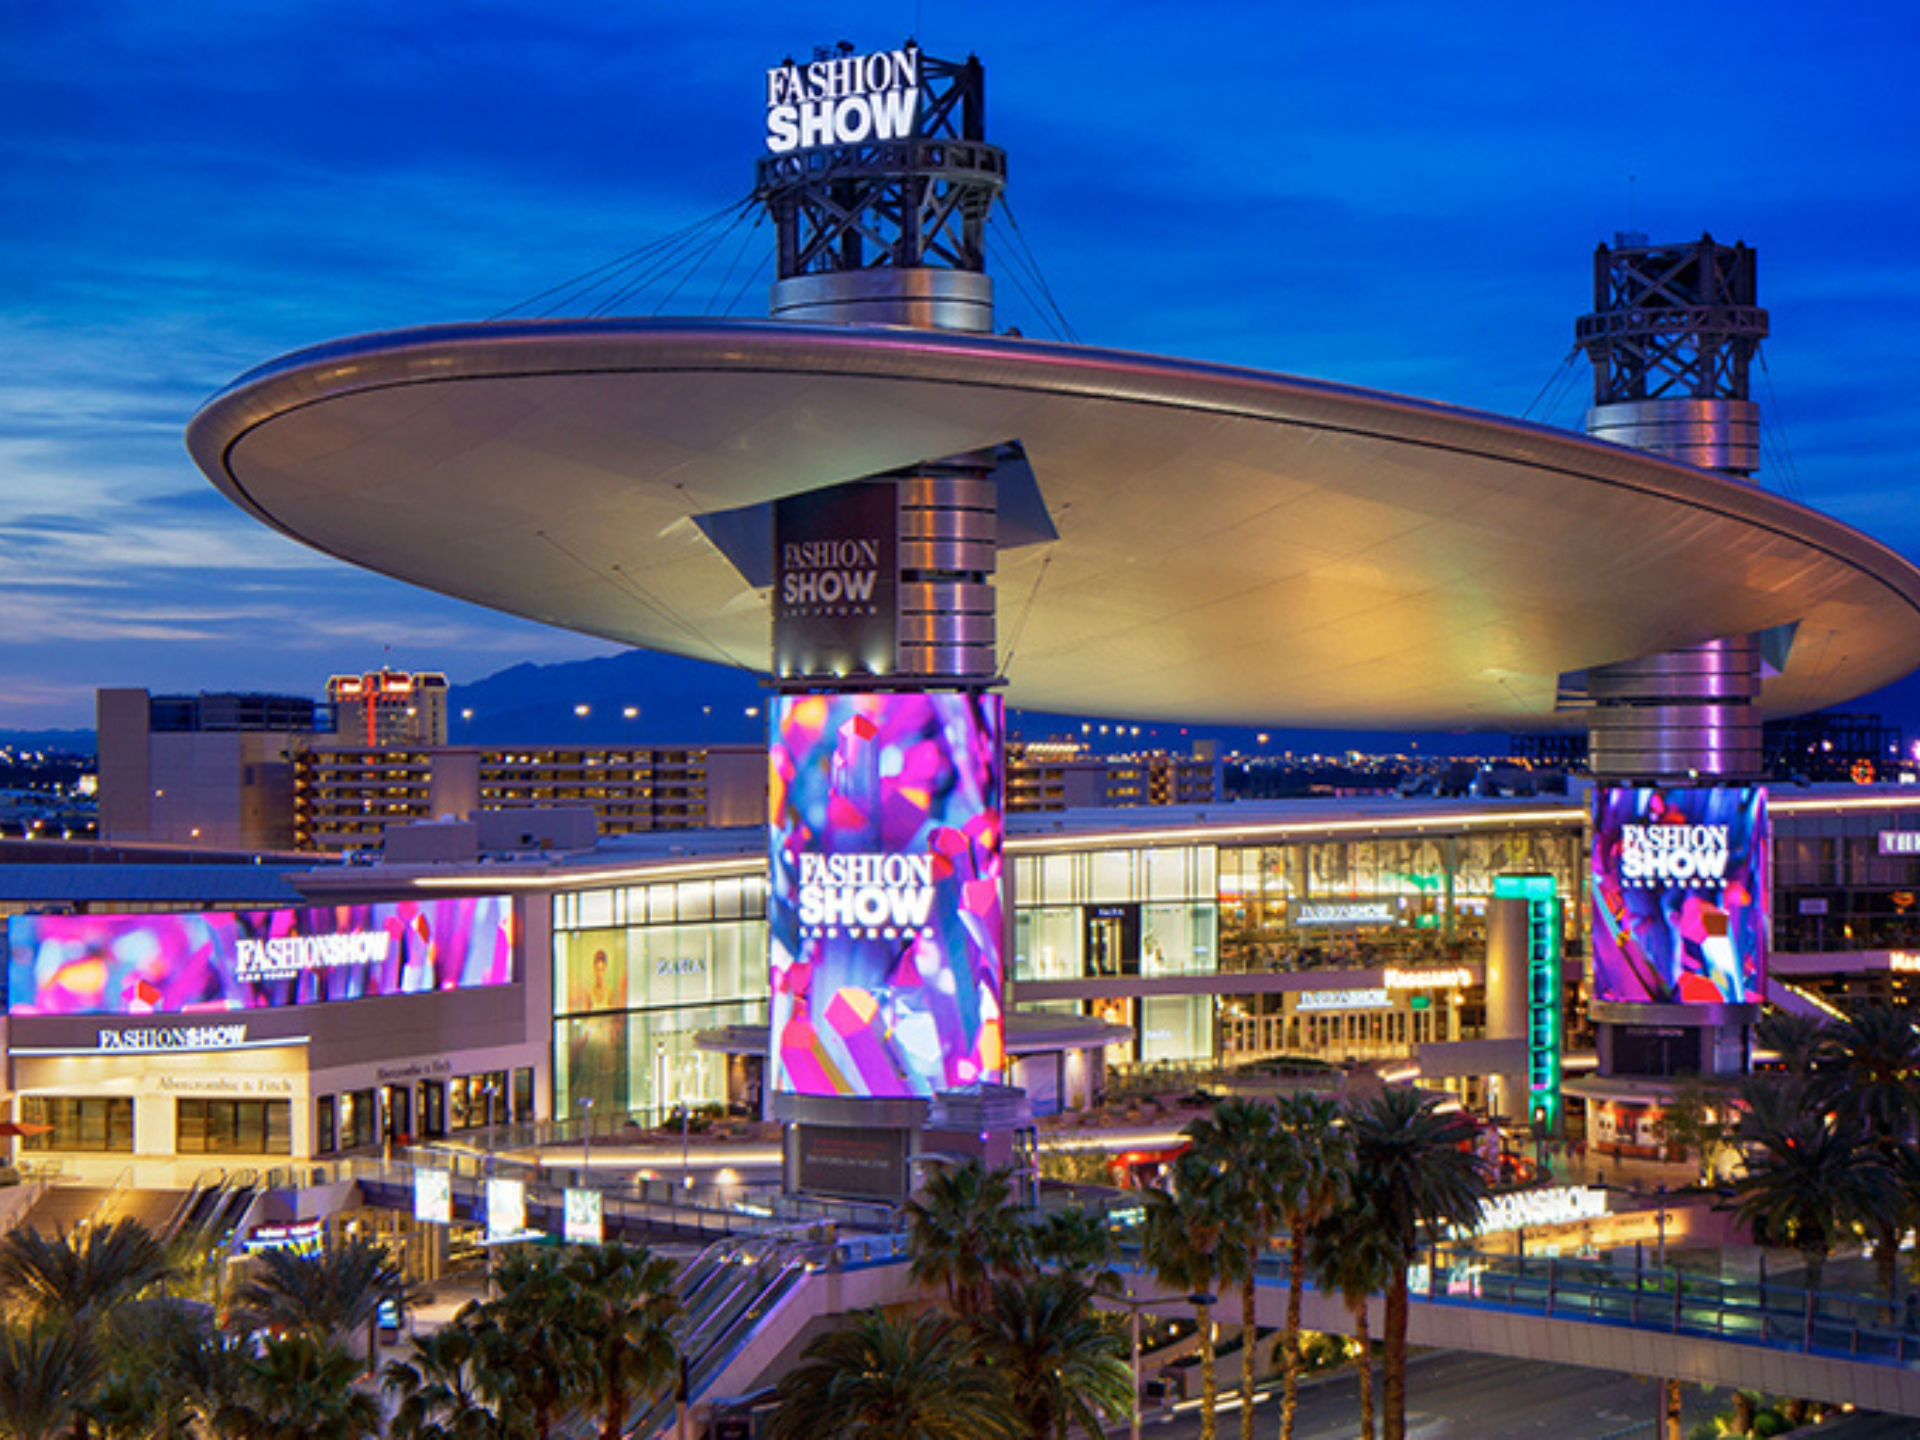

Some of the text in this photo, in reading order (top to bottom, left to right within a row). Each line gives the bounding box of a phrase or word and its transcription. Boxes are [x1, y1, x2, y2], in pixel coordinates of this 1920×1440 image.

[767, 48, 918, 108] FASHION
[766, 87, 919, 153] SHOW
[783, 539, 879, 569] FASHION
[783, 570, 877, 603] SHOW
[1622, 823, 1728, 850] FASHION
[799, 852, 933, 887] FASHION
[1622, 849, 1728, 877] SHOW
[799, 885, 935, 926] SHOW
